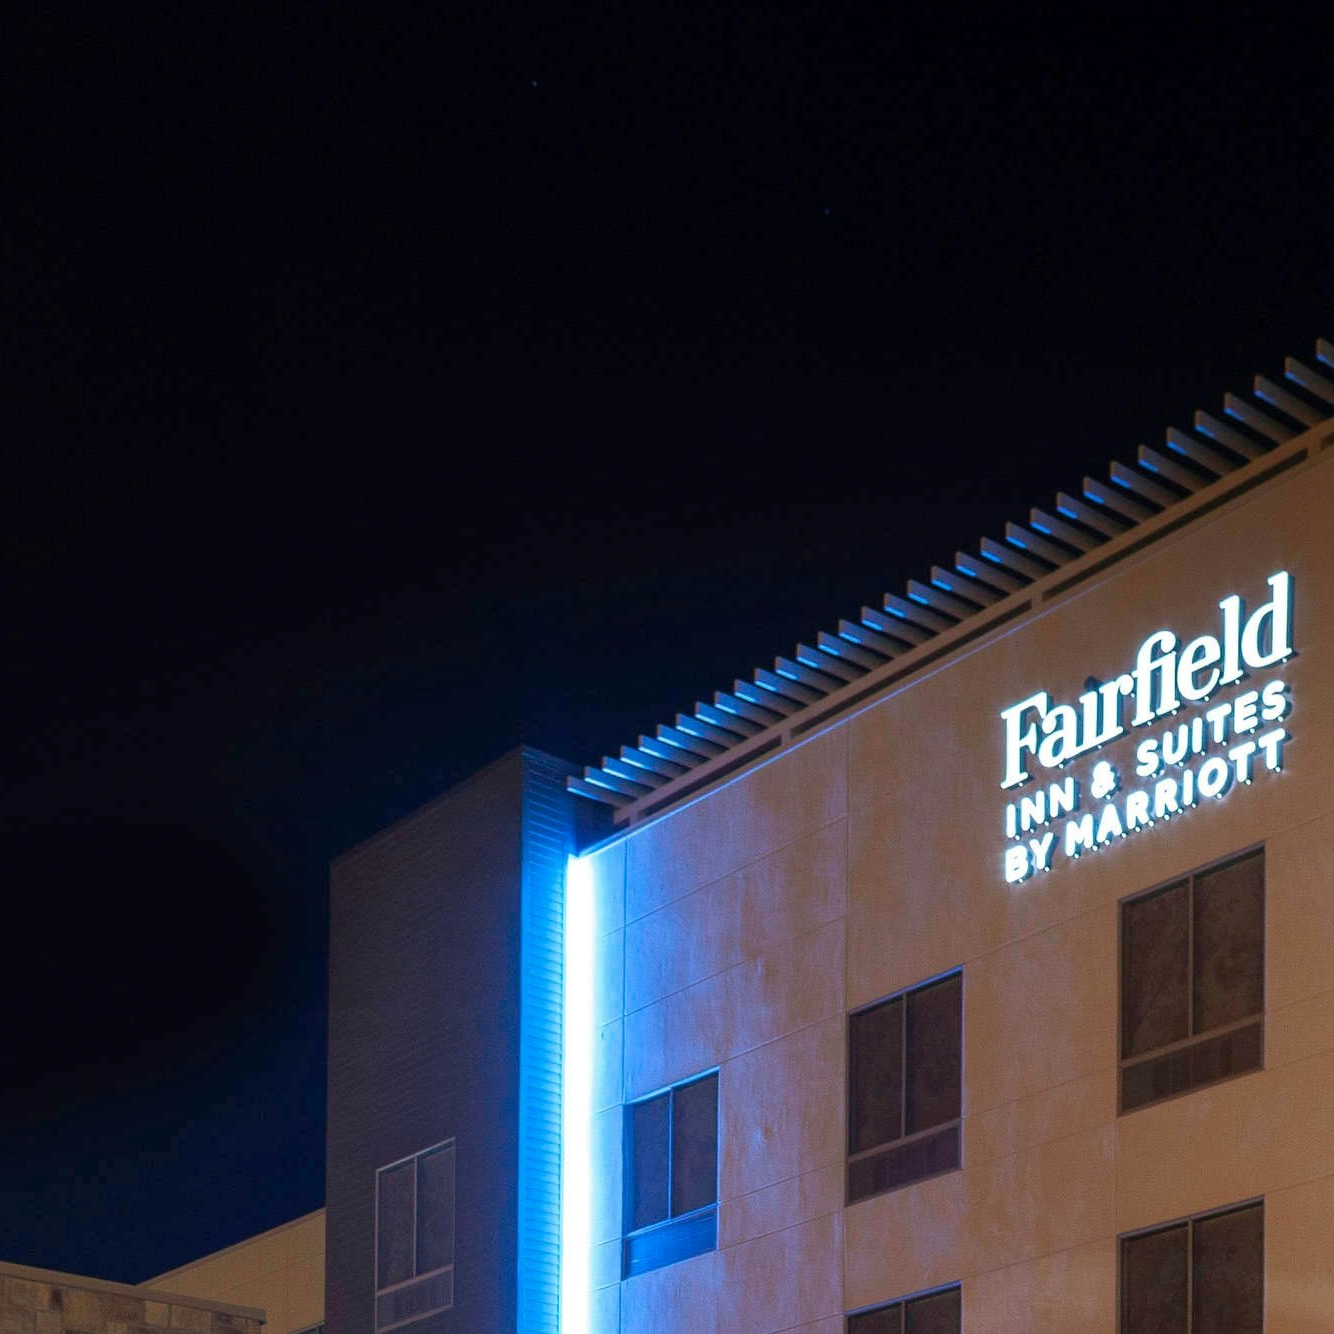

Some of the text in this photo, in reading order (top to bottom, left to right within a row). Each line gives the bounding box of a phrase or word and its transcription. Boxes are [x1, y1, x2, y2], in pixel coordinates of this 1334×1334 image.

[1000, 570, 1293, 790] Fairfield
[1006, 680, 1286, 839] INN & SUITES
[1005, 728, 1286, 883] BY MARRIOTT
